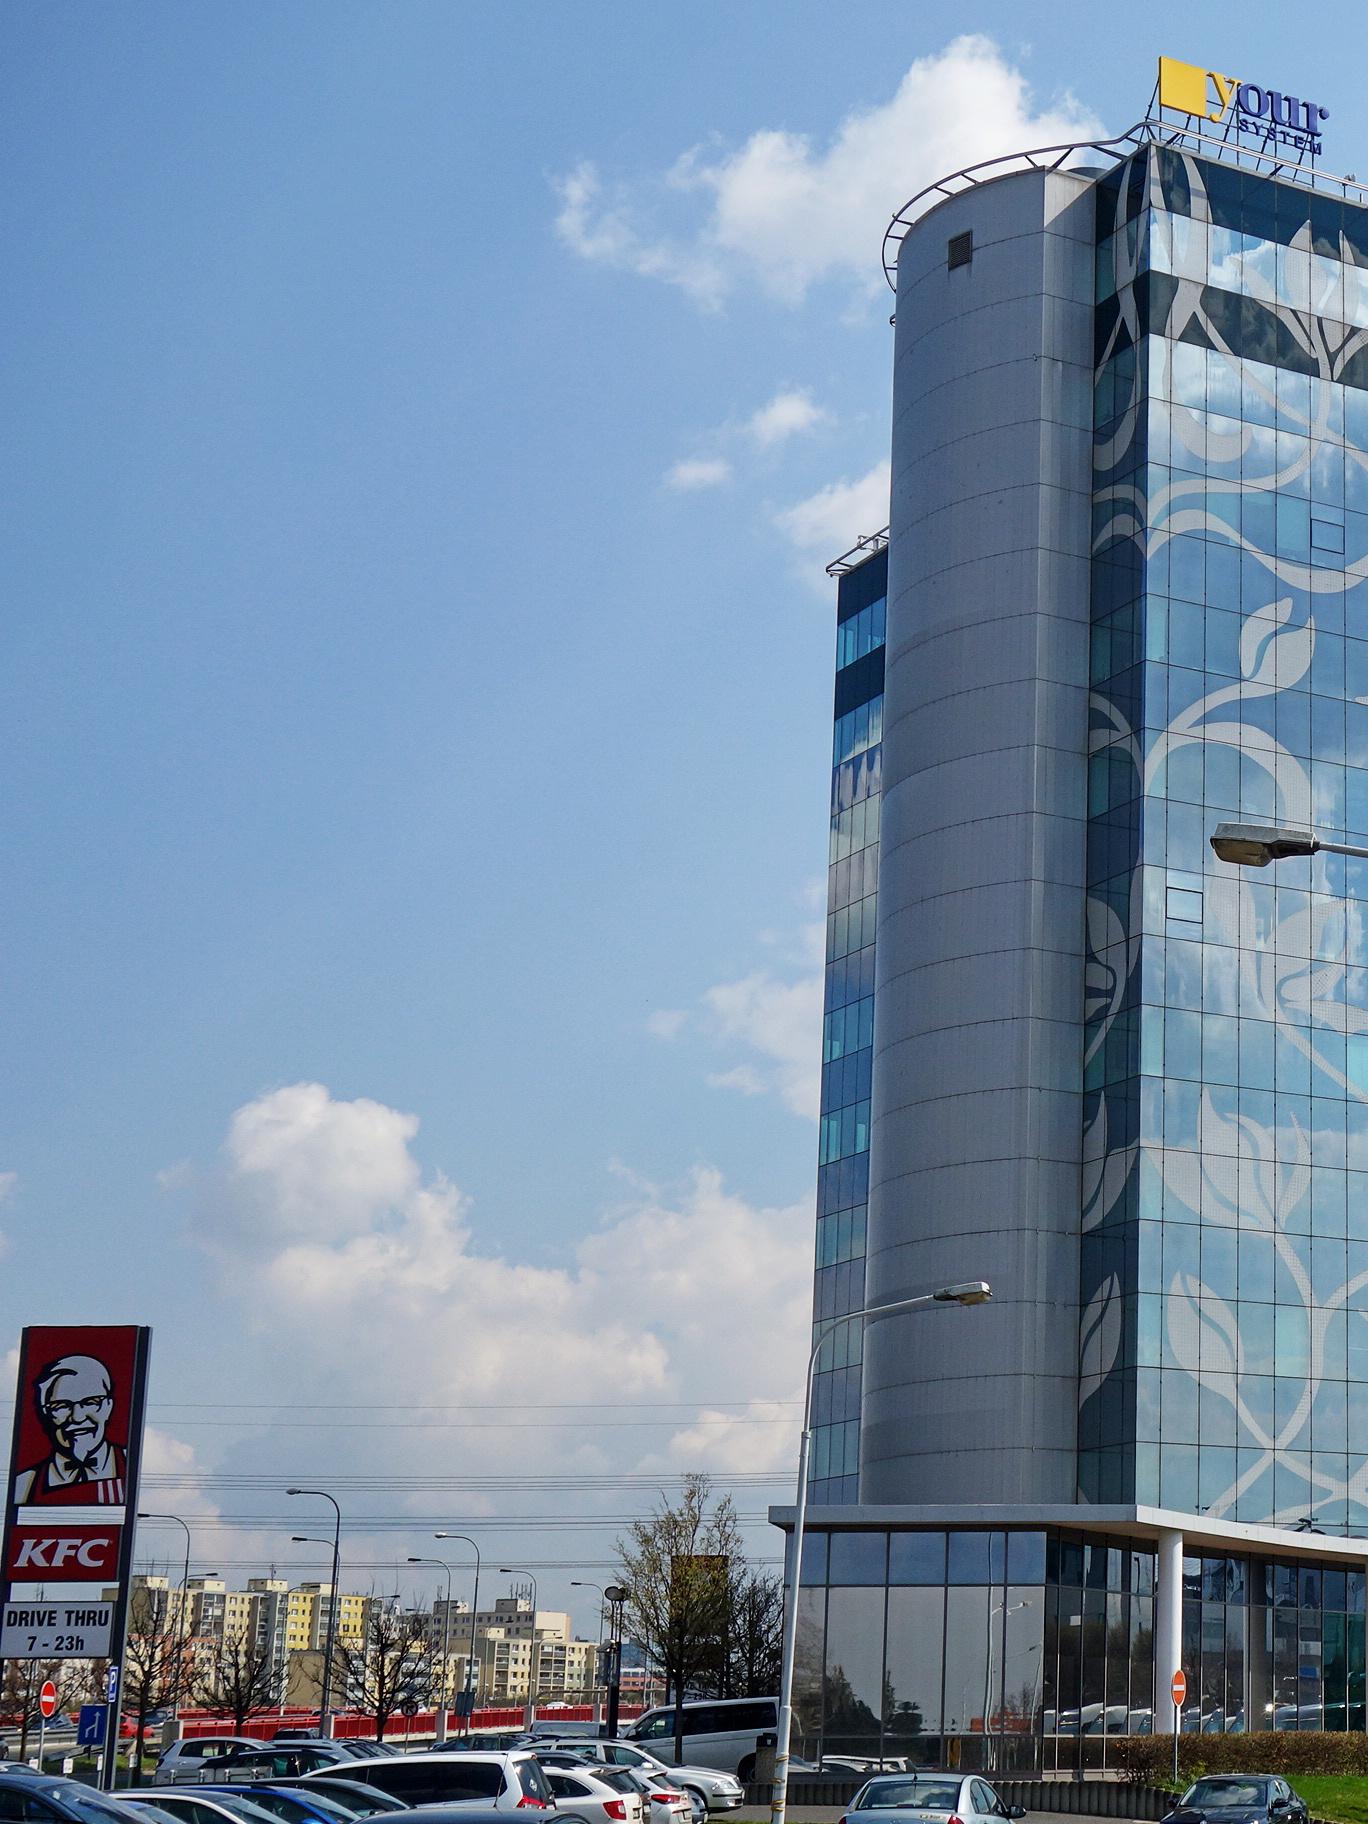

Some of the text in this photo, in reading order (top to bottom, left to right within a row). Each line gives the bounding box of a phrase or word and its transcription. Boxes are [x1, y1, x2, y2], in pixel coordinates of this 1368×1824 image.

[1206, 72, 1330, 136] your
[1238, 118, 1322, 156] SYSTEM
[13, 1538, 109, 1568] KFC
[6, 1609, 110, 1628] DRIVE THRU
[27, 1635, 38, 1652] 7
[54, 1635, 85, 1651] 23h
